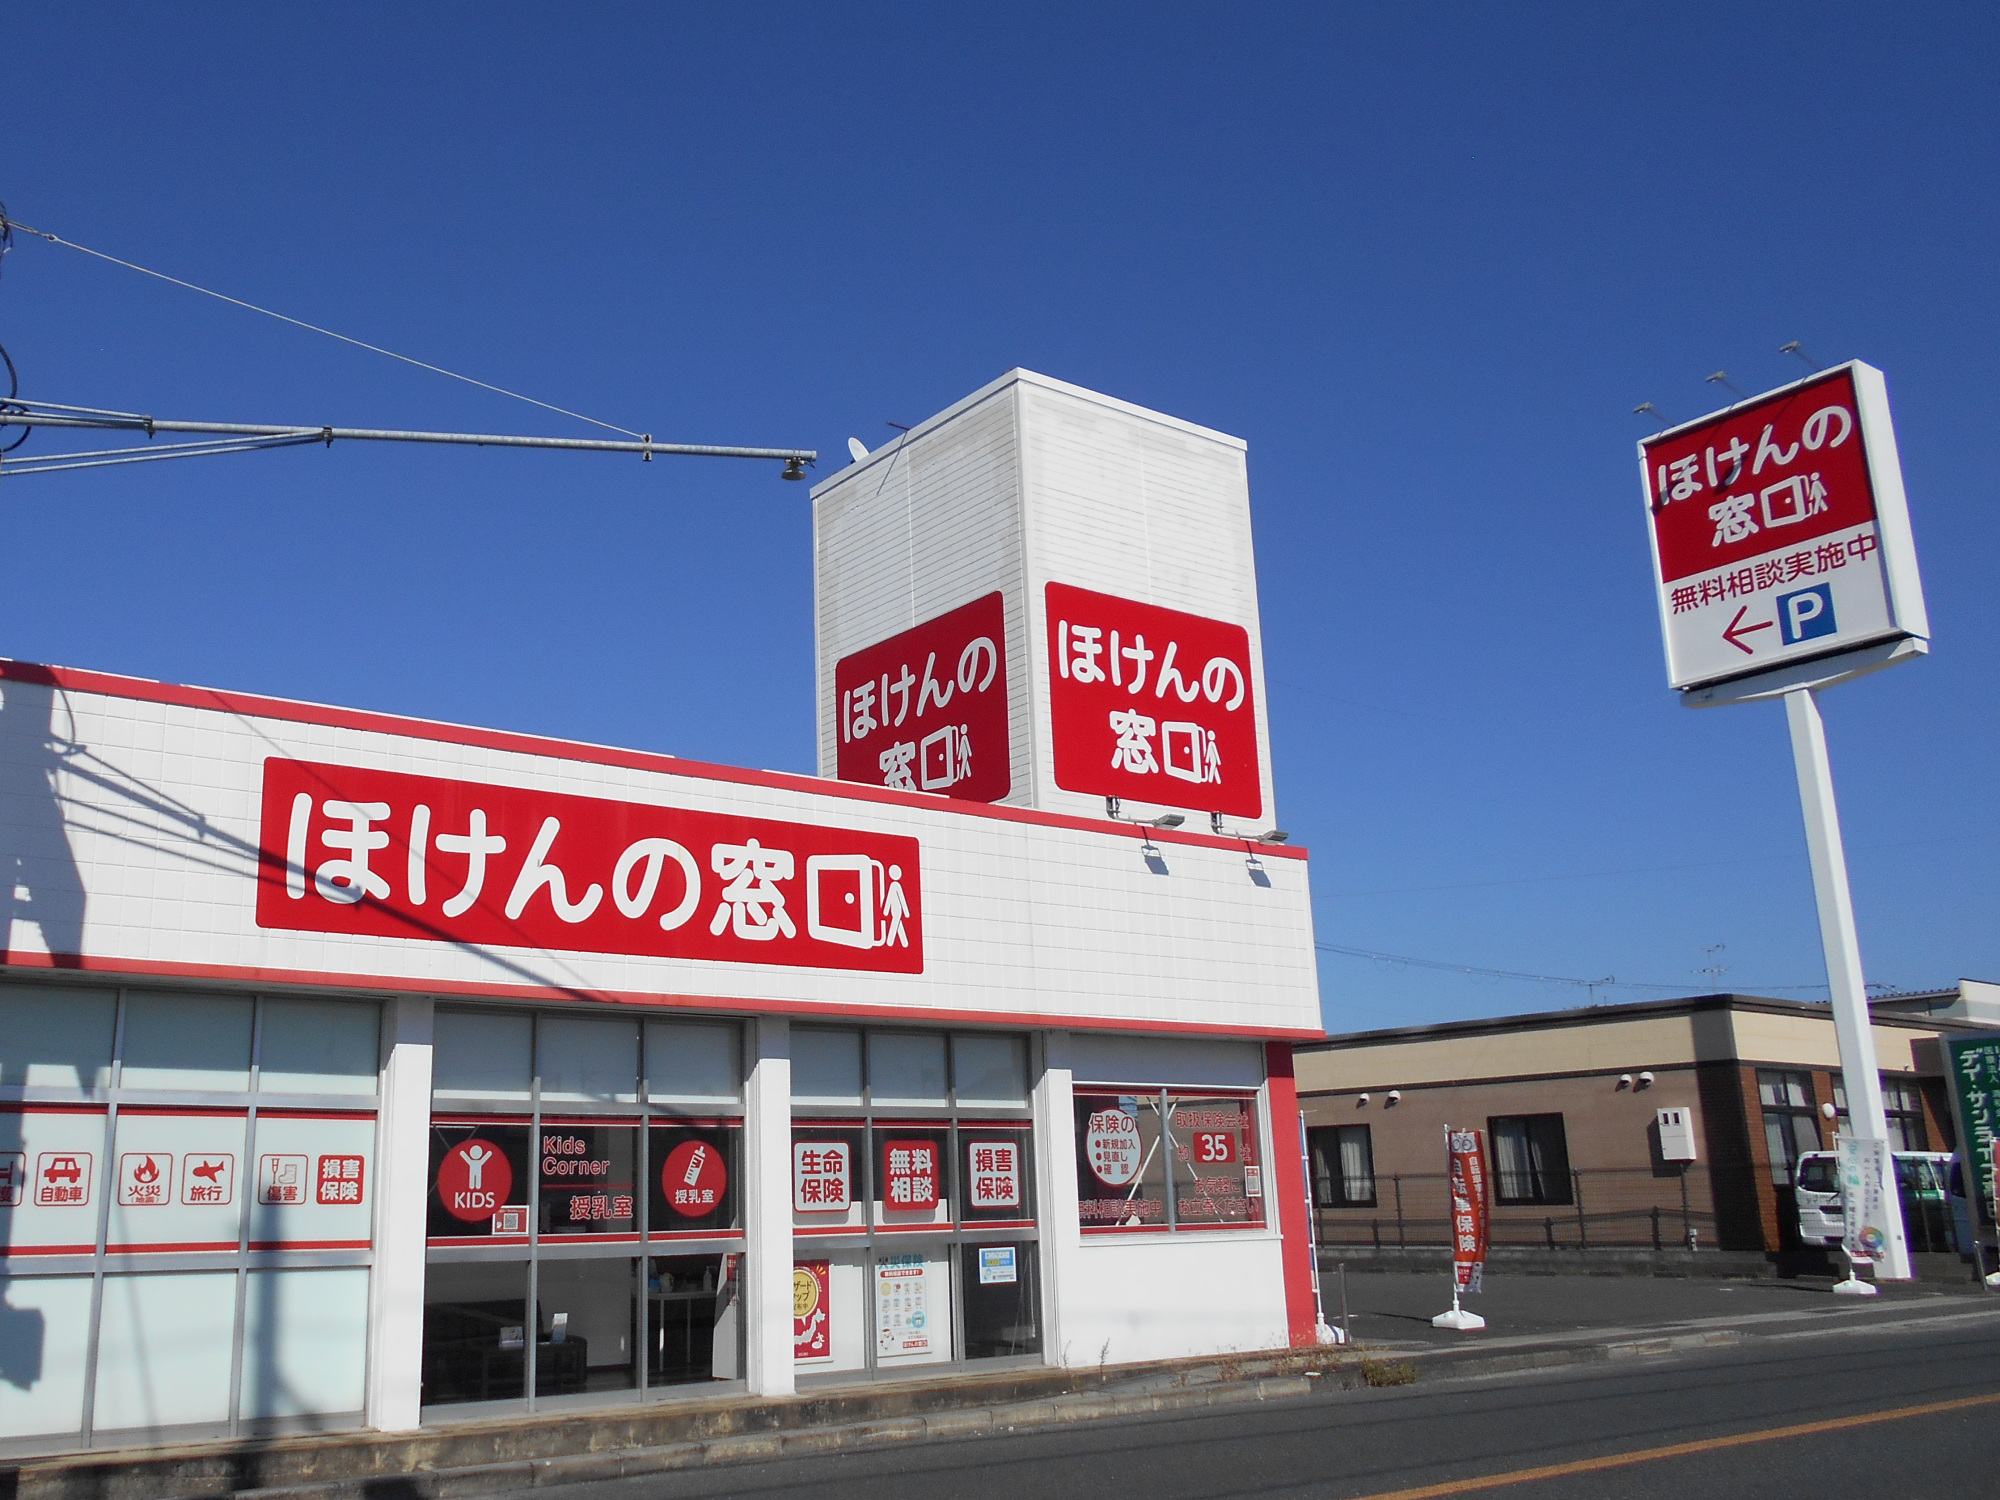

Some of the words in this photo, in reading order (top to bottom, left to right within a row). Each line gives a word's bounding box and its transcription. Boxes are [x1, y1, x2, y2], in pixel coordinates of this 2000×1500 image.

[1658, 405, 1852, 506] ほけんの
[1670, 533, 1877, 614] 無料相談実施中
[1787, 591, 1824, 640] P
[1058, 619, 1246, 712] ほけんの
[843, 636, 997, 744] ほけんの
[1089, 1114, 1135, 1134] 保険の
[1175, 1109, 1250, 1129] 取扱保険会社
[542, 1135, 586, 1155] Kids
[1102, 1138, 1136, 1149] 新規加入
[1178, 1144, 1190, 1161] 約
[1201, 1134, 1228, 1161] 35
[541, 1156, 611, 1176] Corner
[801, 1149, 844, 1175] 生命
[889, 1148, 933, 1175] 無料
[975, 1148, 1013, 1173] 損害
[1103, 1151, 1128, 1162] 見直し
[322, 1158, 360, 1180] 損害
[40, 1186, 83, 1203] 自動車
[127, 1184, 161, 1197] 火災
[190, 1185, 223, 1201] 旅行
[266, 1185, 298, 1202] 傷害
[320, 1180, 360, 1202] 保険
[675, 1188, 715, 1204] 授乳室
[800, 1177, 845, 1203] 保険
[891, 1176, 934, 1203] 相談
[975, 1176, 1014, 1201] 保険
[1194, 1176, 1240, 1194] お気軽に
[453, 1191, 496, 1210] KIDS
[569, 1195, 634, 1220] 授乳室
[1178, 1197, 1260, 1216] お立寄ください
[1452, 1157, 1477, 1252] 自転車保険
[879, 1254, 923, 1269] 火災保険
